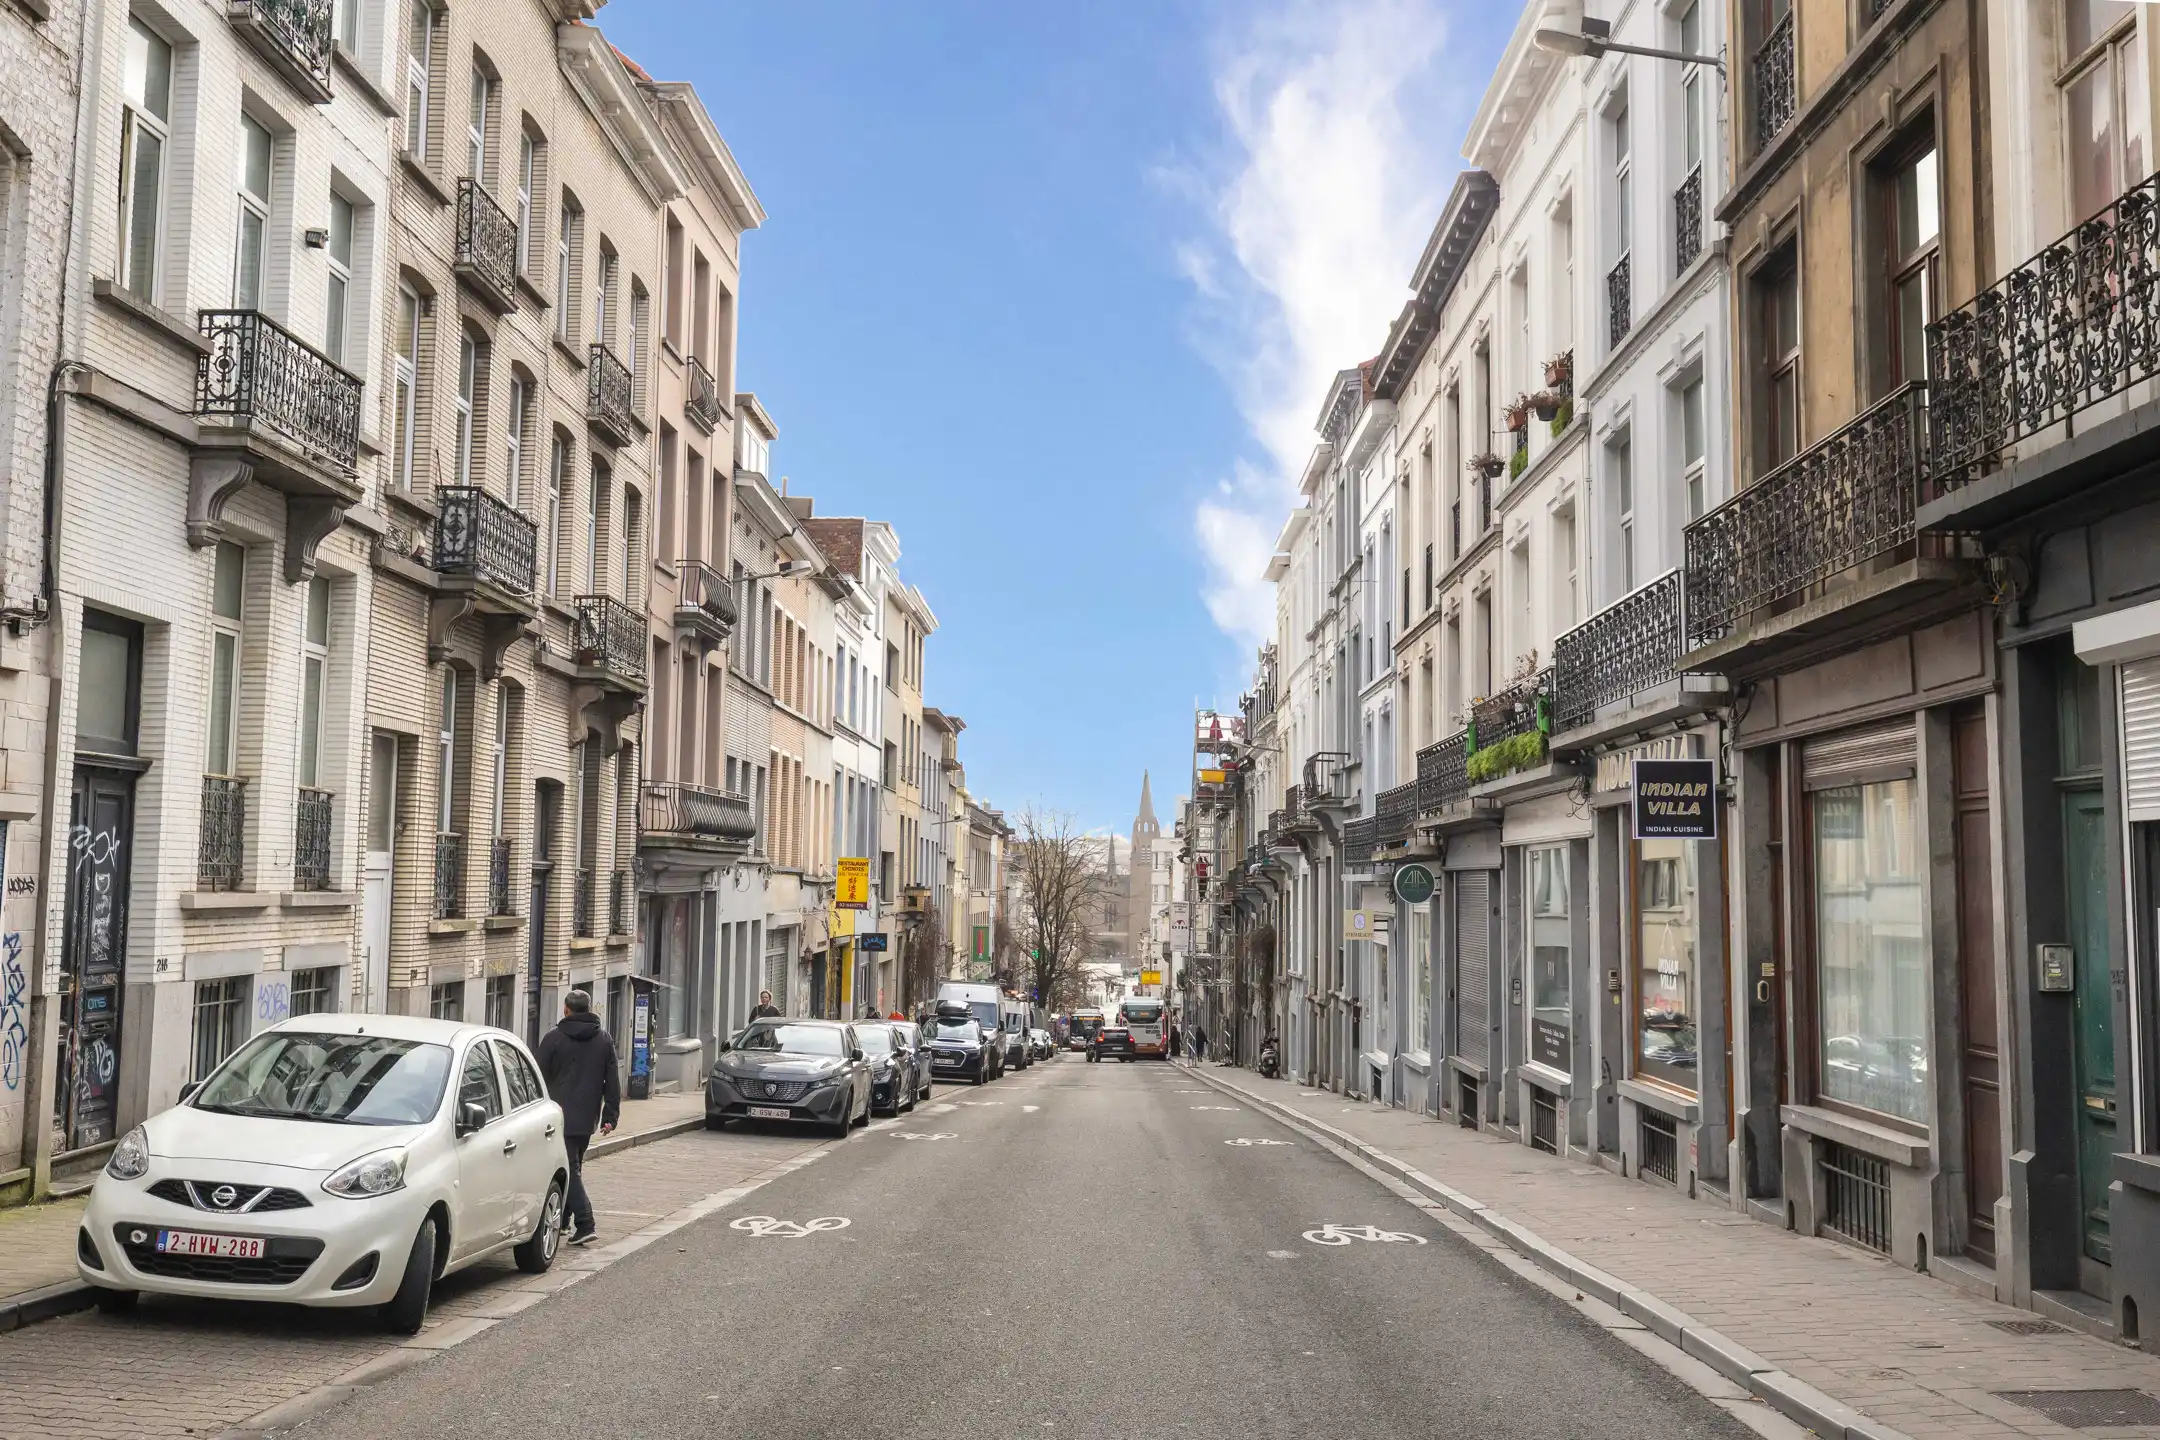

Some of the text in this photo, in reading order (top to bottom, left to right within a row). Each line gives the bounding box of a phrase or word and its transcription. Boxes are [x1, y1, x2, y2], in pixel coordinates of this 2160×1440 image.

[1640, 782, 1708, 797] INDIAN
[1647, 801, 1701, 816] VILLA
[156, 958, 168, 972] 218
[1657, 958, 1679, 976] INDIAN
[1660, 973, 1677, 991] VILLA
[157, 1234, 258, 1257] B 2-HVW-288
